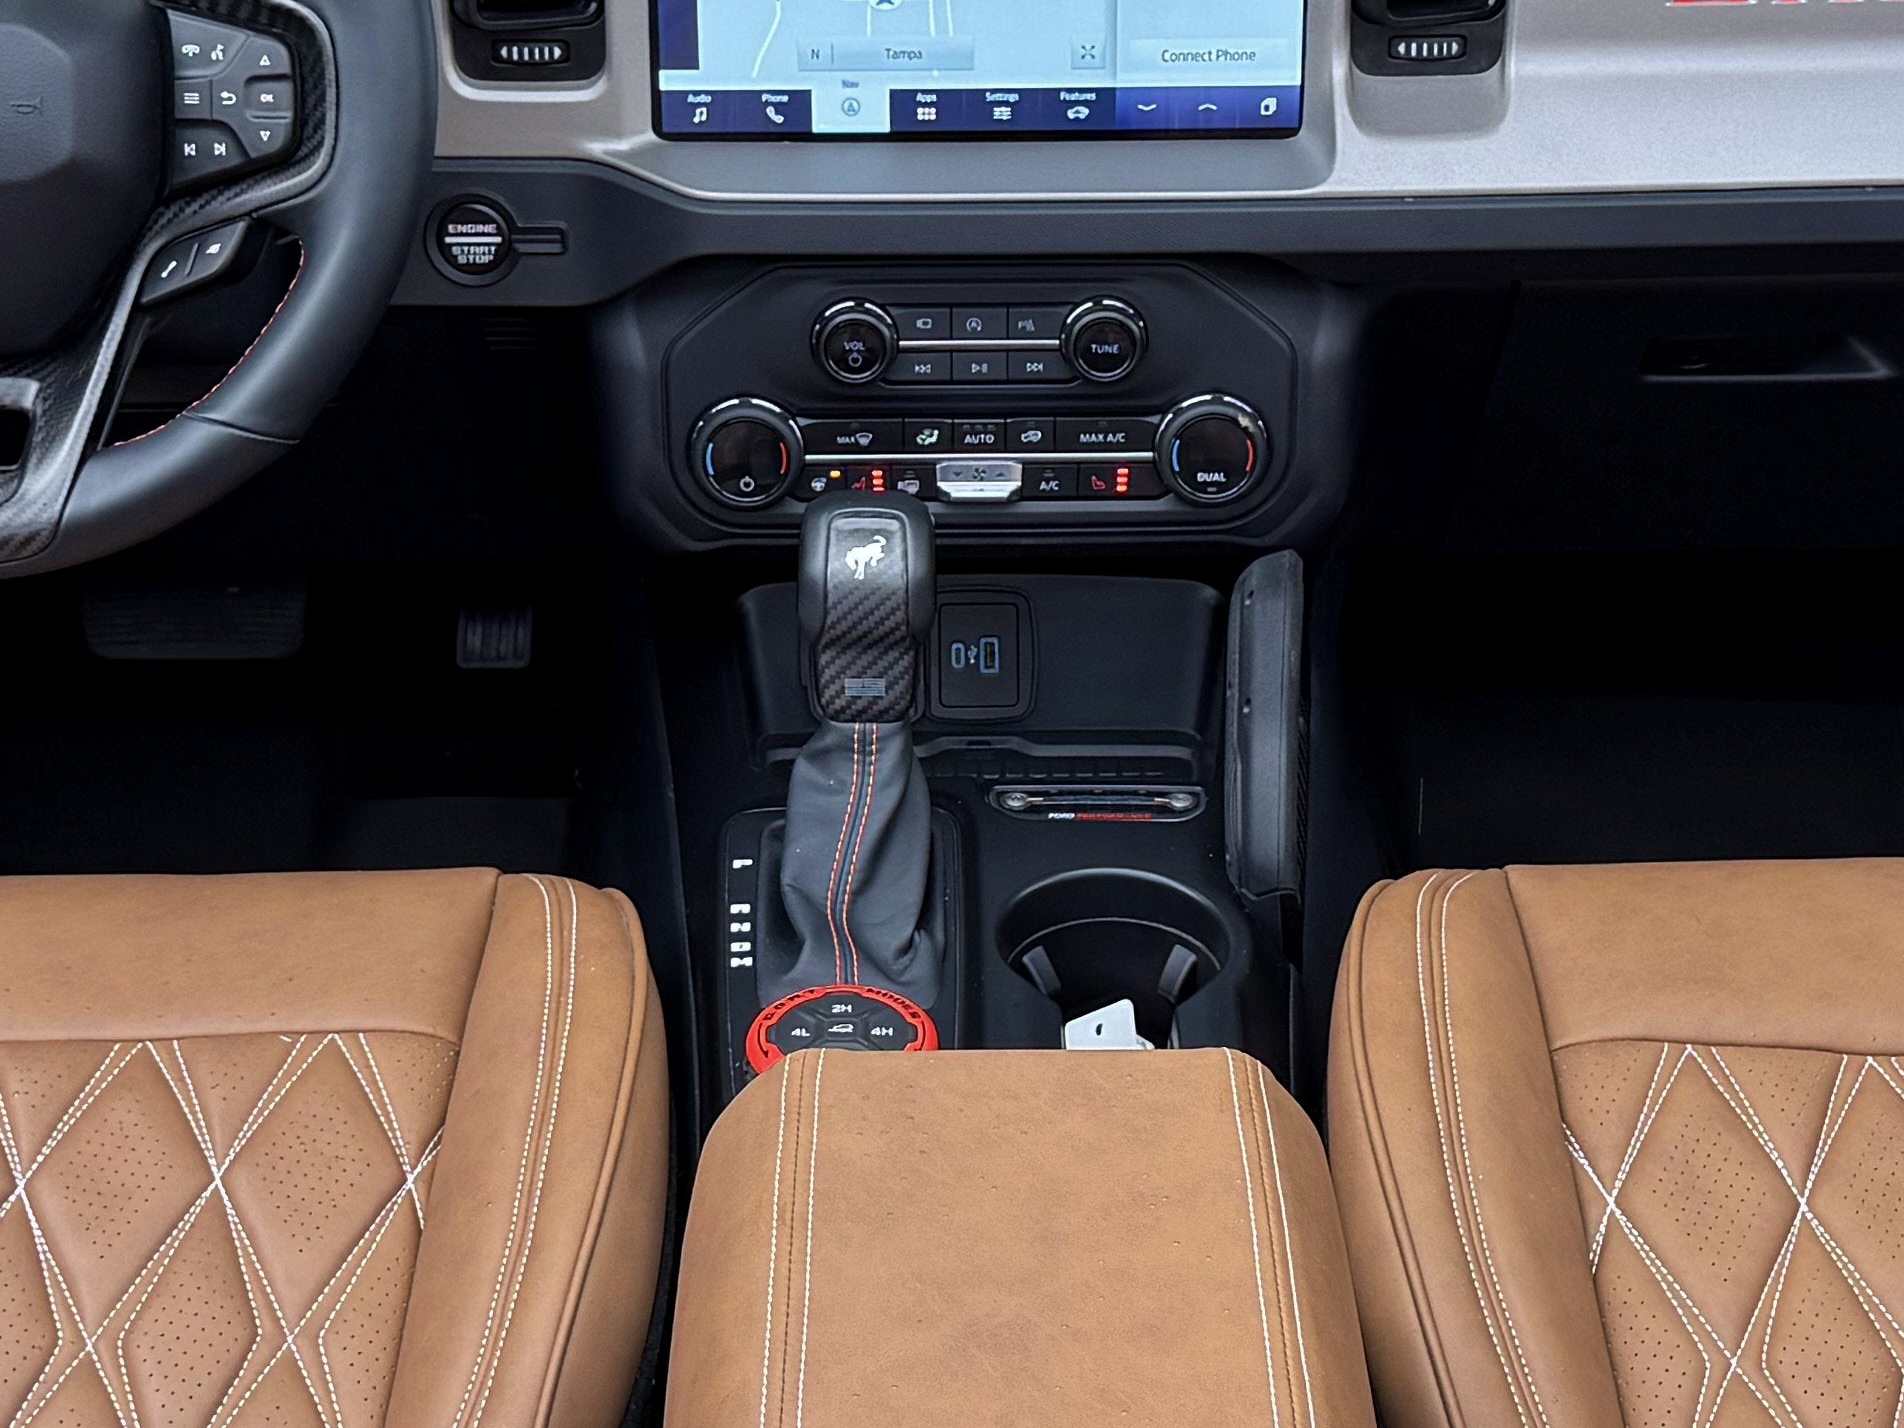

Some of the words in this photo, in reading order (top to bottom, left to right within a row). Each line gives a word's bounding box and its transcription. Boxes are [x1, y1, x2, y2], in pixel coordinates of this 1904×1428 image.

[811, 49, 820, 60] N
[885, 48, 923, 62] Tampa
[1161, 49, 1212, 63] Connect
[1215, 48, 1257, 62] Phone
[842, 80, 859, 89] Nav
[762, 93, 789, 103] Phone
[916, 93, 937, 104] Apps
[1060, 91, 1096, 102] Features
[447, 224, 498, 234] ENGINE
[451, 246, 496, 255] START
[457, 255, 494, 264] STOP
[844, 341, 865, 351] VOL
[1090, 343, 1120, 354] TUNE
[964, 434, 995, 444] AUTO
[1079, 433, 1104, 443] MAX
[1106, 433, 1126, 443] A/C
[1197, 472, 1227, 482] DUAL
[1039, 480, 1060, 491] A/C
[831, 1004, 852, 1013] 2H
[791, 1028, 810, 1037] 4L
[870, 1027, 893, 1036] 4H
